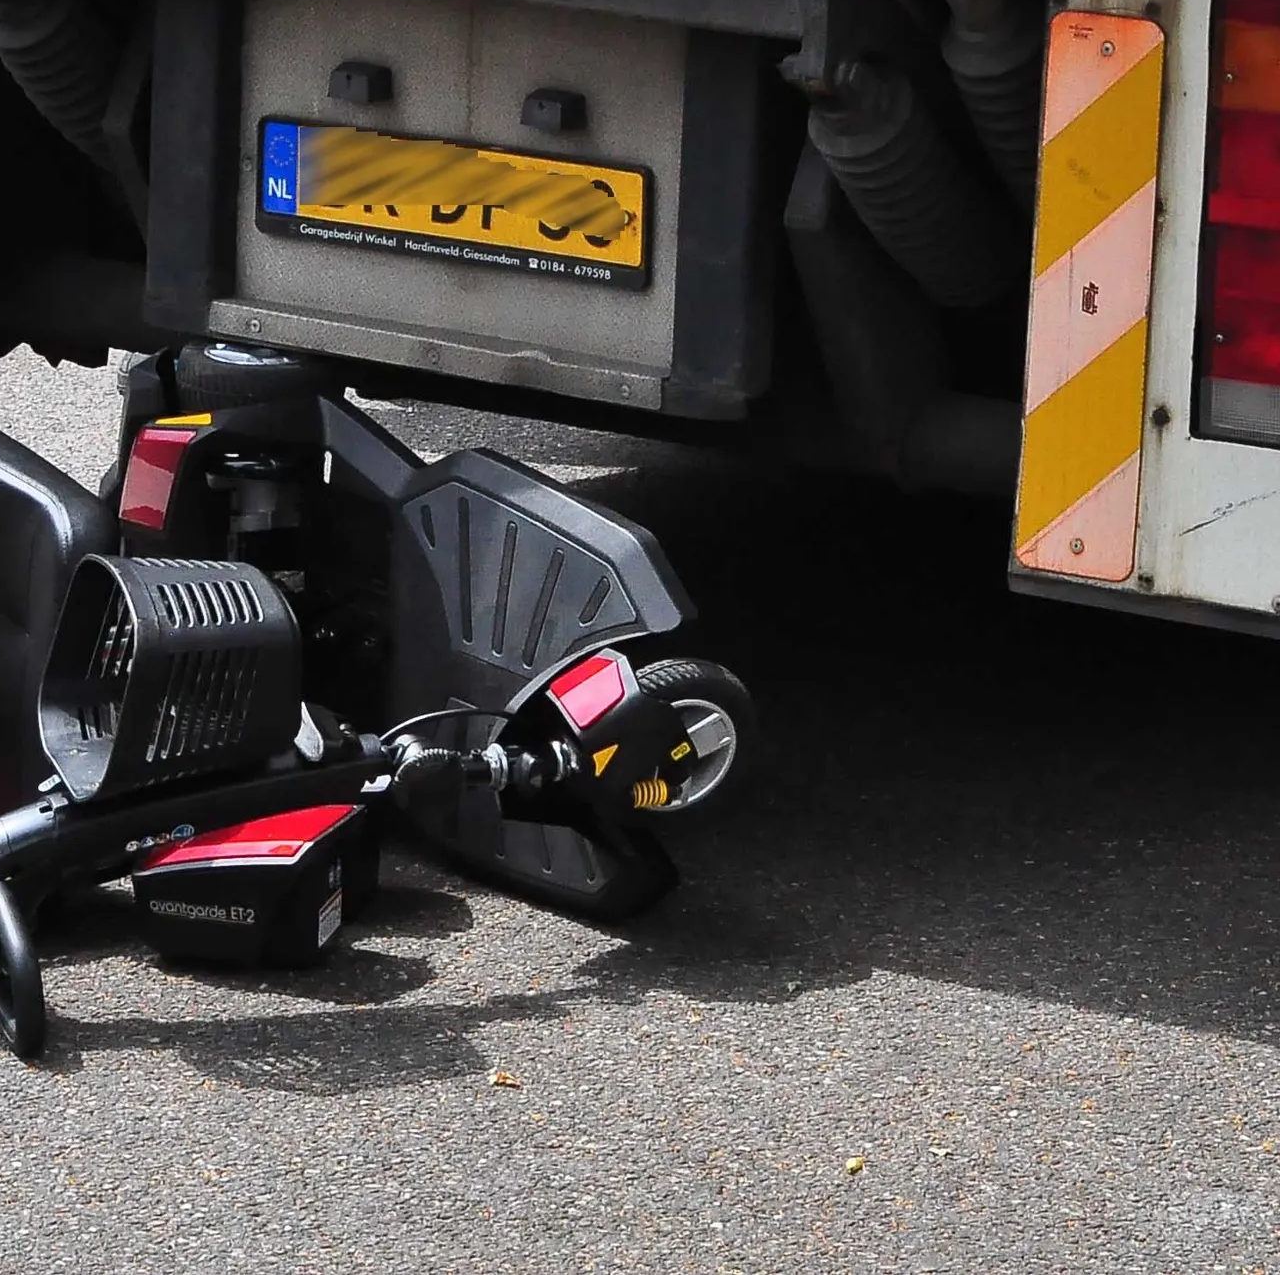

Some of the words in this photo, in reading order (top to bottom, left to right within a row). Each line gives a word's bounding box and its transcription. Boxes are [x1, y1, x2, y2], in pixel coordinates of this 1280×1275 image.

[267, 176, 293, 200] NL
[299, 223, 363, 244] Garagebedrijf
[365, 233, 397, 247] Winkel
[540, 259, 565, 273] 0184
[574, 264, 612, 280] 679598
[149, 900, 227, 919] avantgarde
